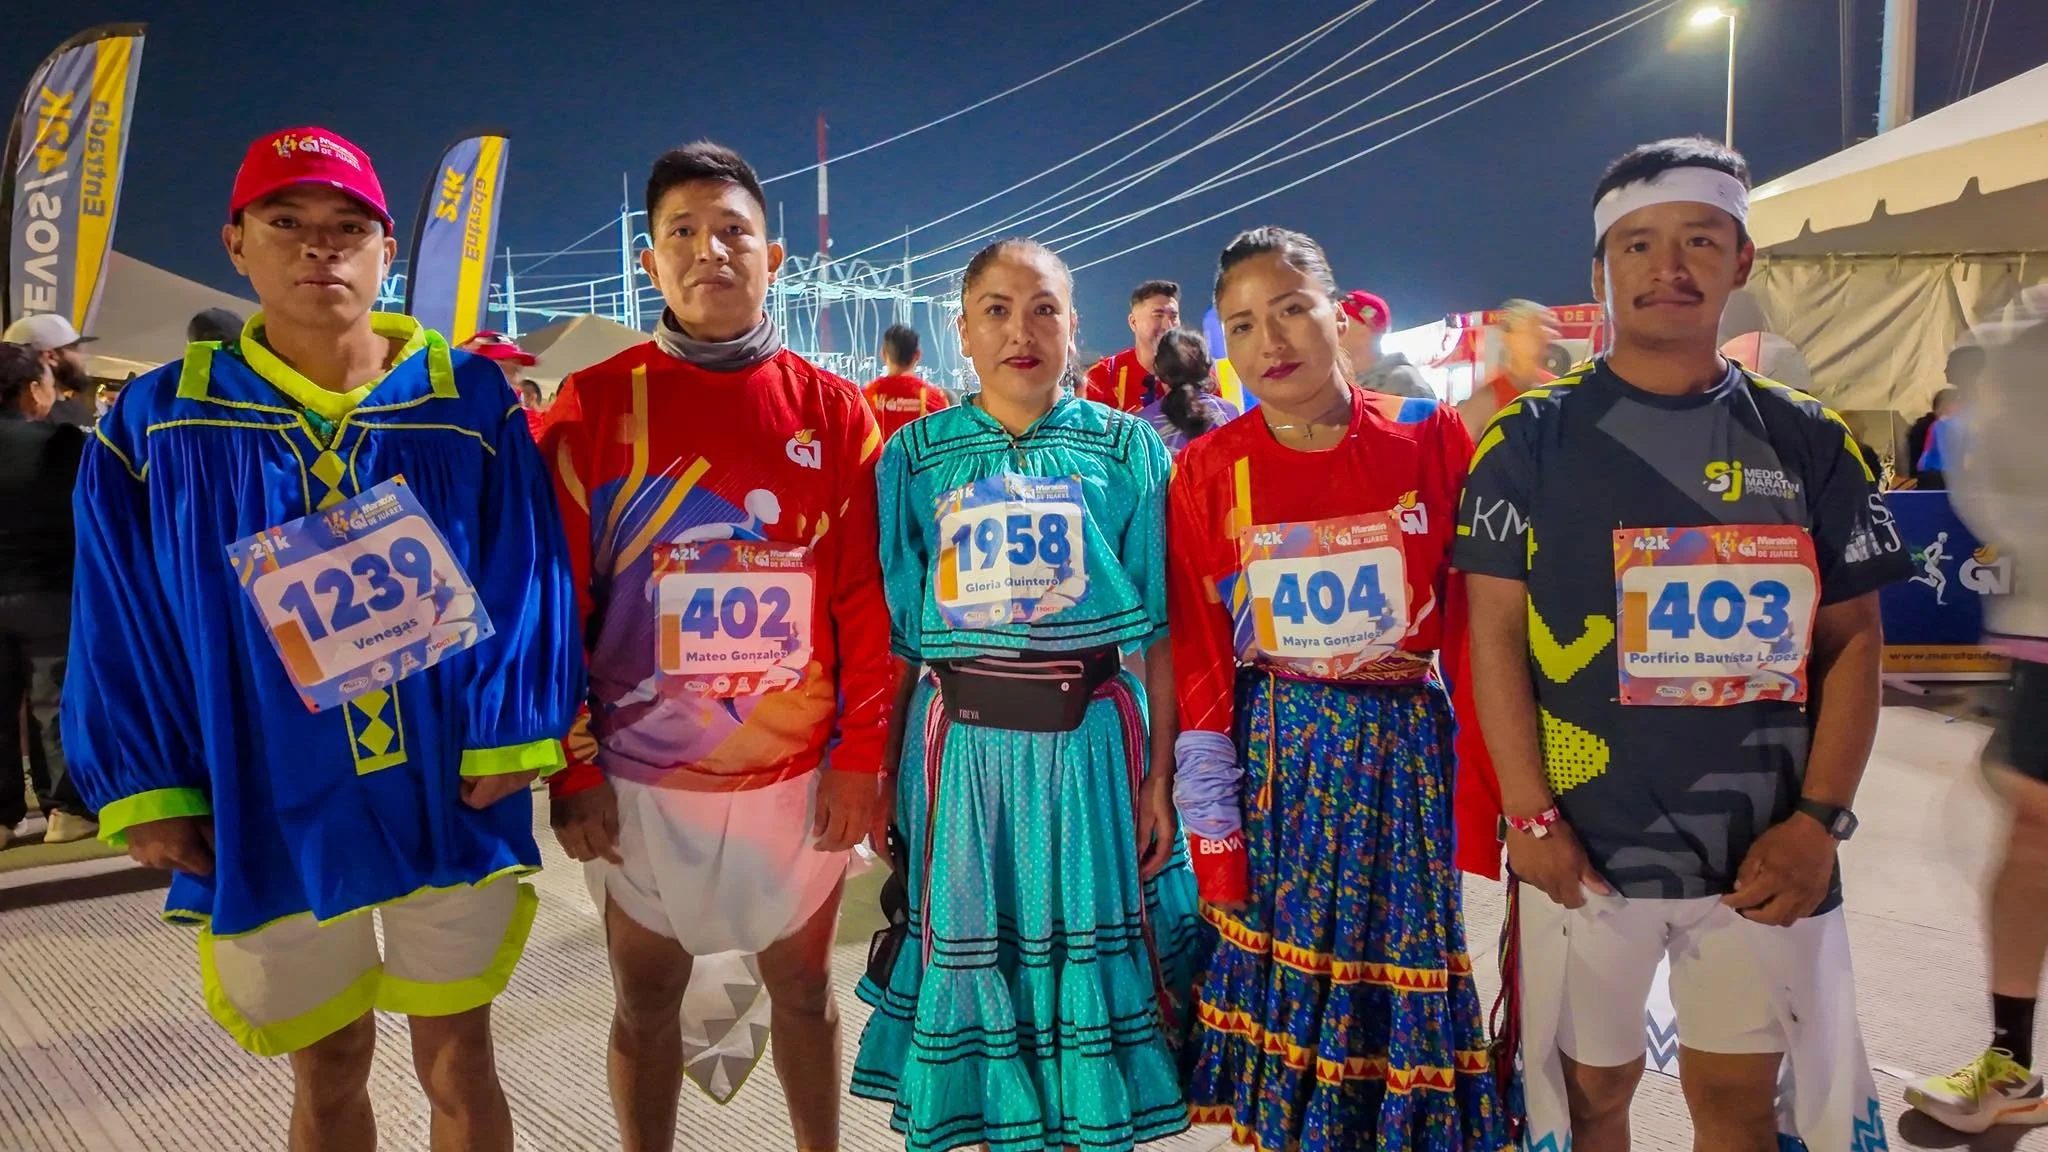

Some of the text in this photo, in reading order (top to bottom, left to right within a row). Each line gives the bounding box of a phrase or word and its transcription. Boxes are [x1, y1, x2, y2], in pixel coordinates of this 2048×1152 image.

[1743, 468, 1784, 480] MEDIO
[951, 513, 1071, 572] 1958
[1253, 531, 1284, 545] 42k
[1633, 535, 1670, 551] 42k
[670, 547, 700, 561] 42k
[1757, 550, 1768, 558] DE
[279, 537, 432, 642] 1239
[965, 577, 1060, 593] Gloria Quintero
[1272, 564, 1386, 625] 404
[681, 586, 791, 640] 402
[1648, 580, 1790, 640] 403
[352, 617, 419, 650] Venegas
[1283, 630, 1382, 648] Mayra Gonzalez
[686, 649, 788, 662] Mateo Gonzalez
[1630, 651, 1799, 664] Porfirio Bautista Lopez
